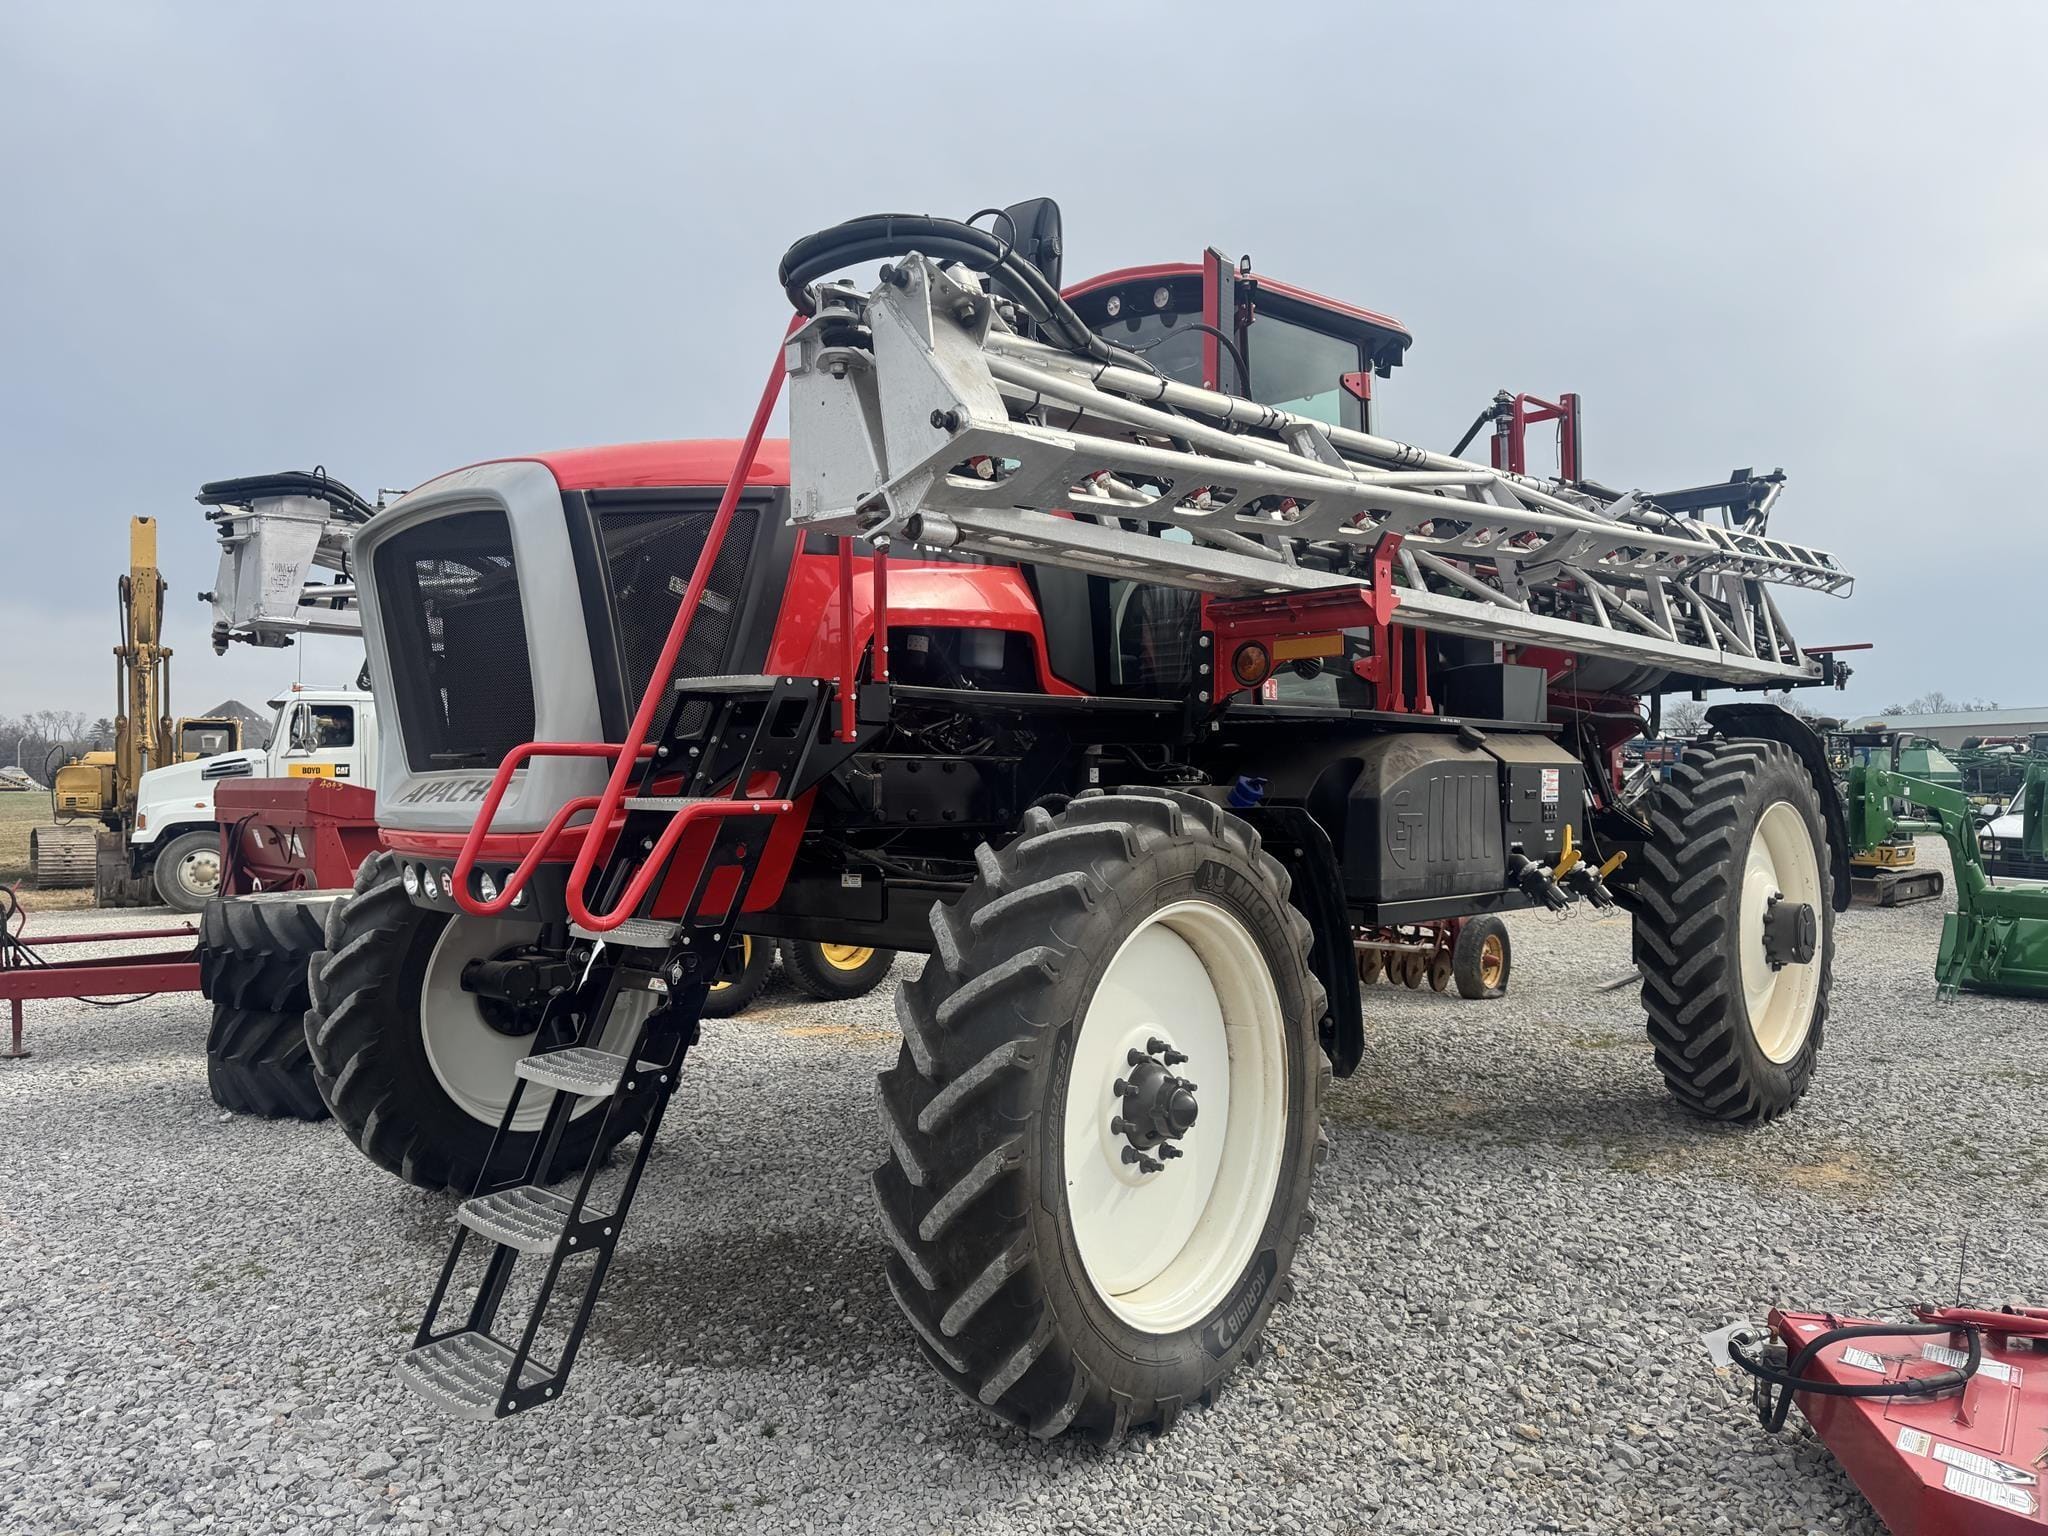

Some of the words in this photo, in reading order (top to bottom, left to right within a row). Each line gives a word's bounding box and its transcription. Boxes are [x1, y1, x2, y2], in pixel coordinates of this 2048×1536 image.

[302, 767, 321, 775] BOYD
[335, 766, 350, 775] CAT
[398, 779, 514, 803] APACH
[1880, 849, 1893, 863] 17
[1227, 1264, 1267, 1334] AGRIBIB
[1211, 1317, 1232, 1350] 2
